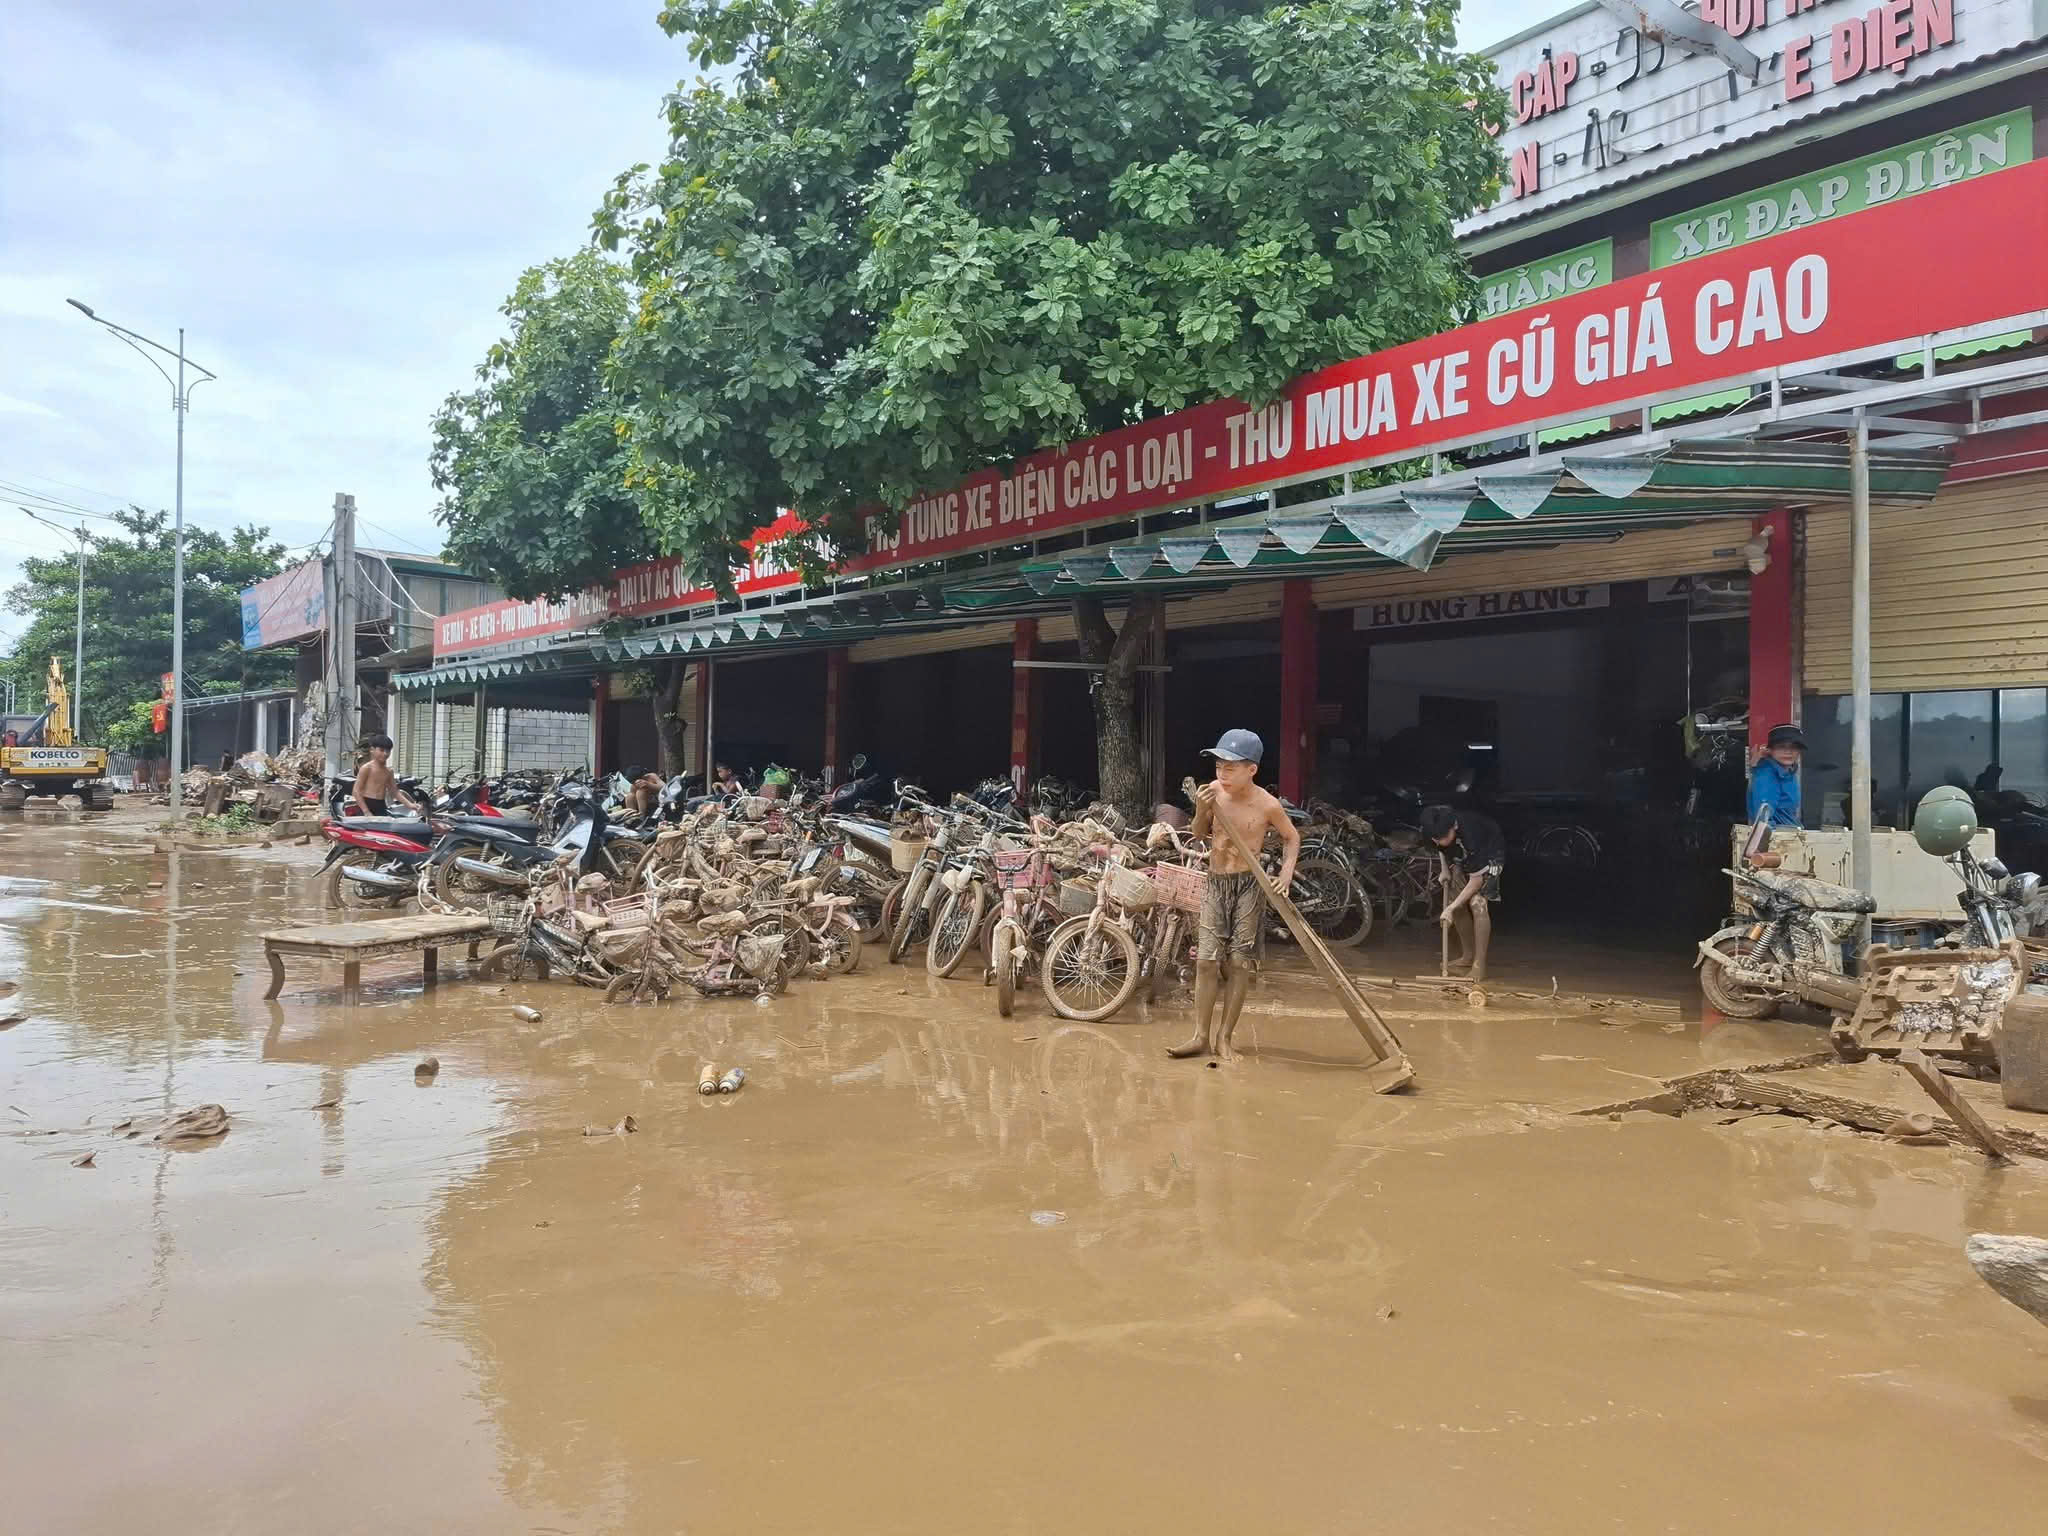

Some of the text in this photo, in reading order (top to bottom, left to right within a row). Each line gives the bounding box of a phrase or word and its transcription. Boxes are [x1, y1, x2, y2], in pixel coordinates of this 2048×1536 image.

[1672, 208, 1734, 261] XE
[1865, 125, 2011, 206] ĐIỆN
[906, 493, 959, 545] TÙNG
[964, 484, 993, 532] XE
[999, 464, 1055, 526] ĐIỆN
[1063, 444, 1117, 508] CÁC
[1126, 428, 1192, 494] LOẠI
[1305, 373, 1398, 451] MUA
[1411, 350, 1470, 426] XE
[1487, 314, 1555, 406] CŨ
[1574, 282, 1673, 386] GIÁ
[1695, 254, 1829, 357] CAO
[31, 750, 80, 759] KOBELCO
